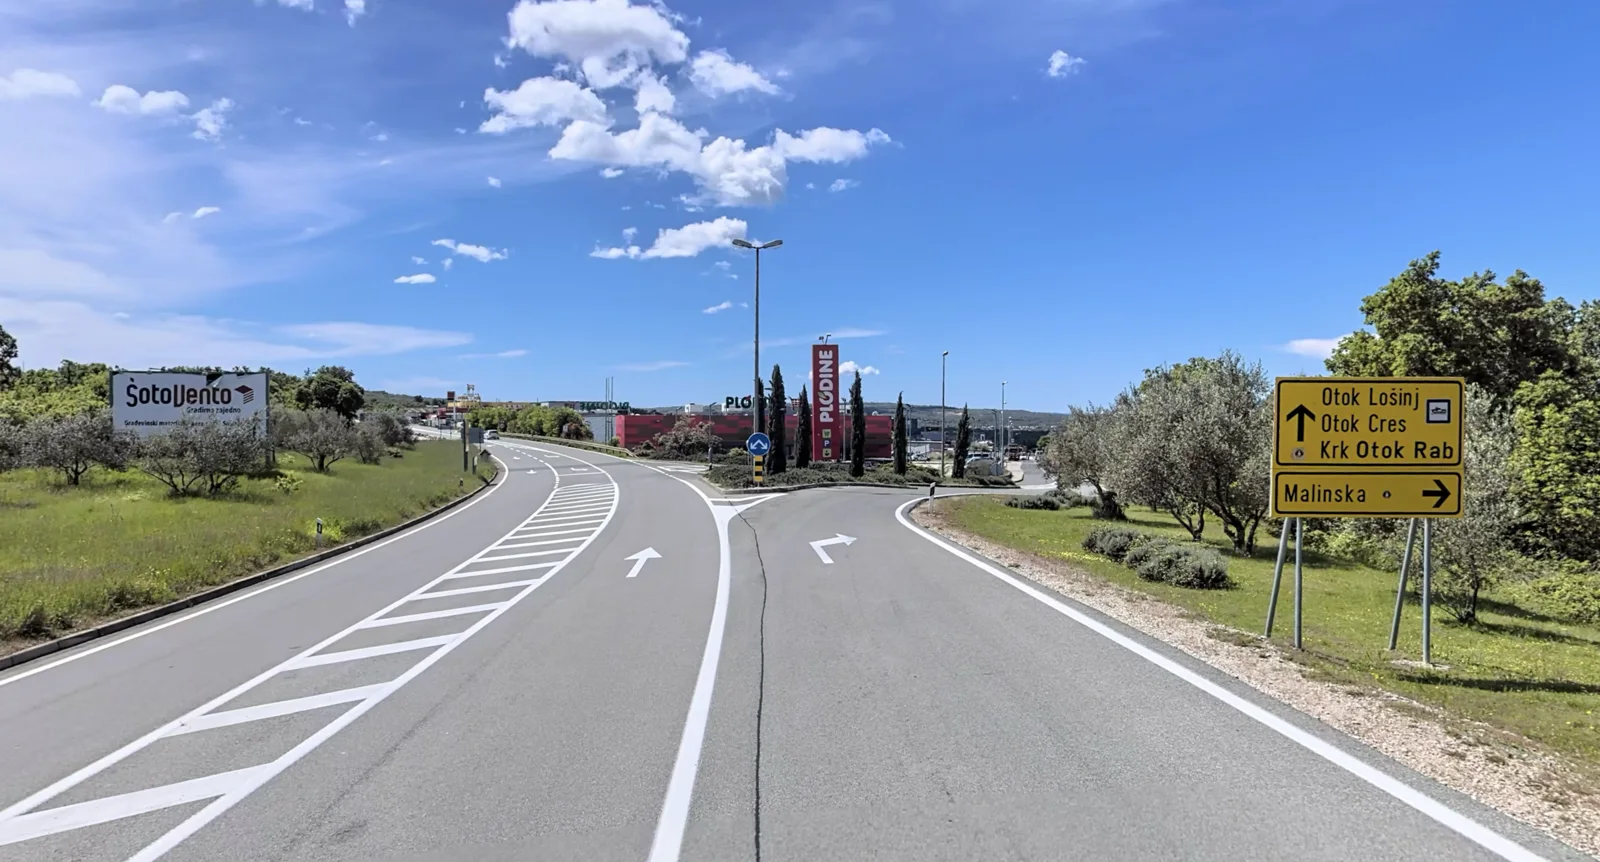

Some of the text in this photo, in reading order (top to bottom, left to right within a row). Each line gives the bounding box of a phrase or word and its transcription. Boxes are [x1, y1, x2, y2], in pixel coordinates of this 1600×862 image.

[818, 350, 833, 422] PLODINE
[1322, 387, 1419, 410] Otok Lošinj
[216, 407, 241, 415] zajedno
[1321, 414, 1407, 432] Otok Cres
[1320, 440, 1454, 459] Krk Otok Rab
[1284, 484, 1366, 502] Malinska
